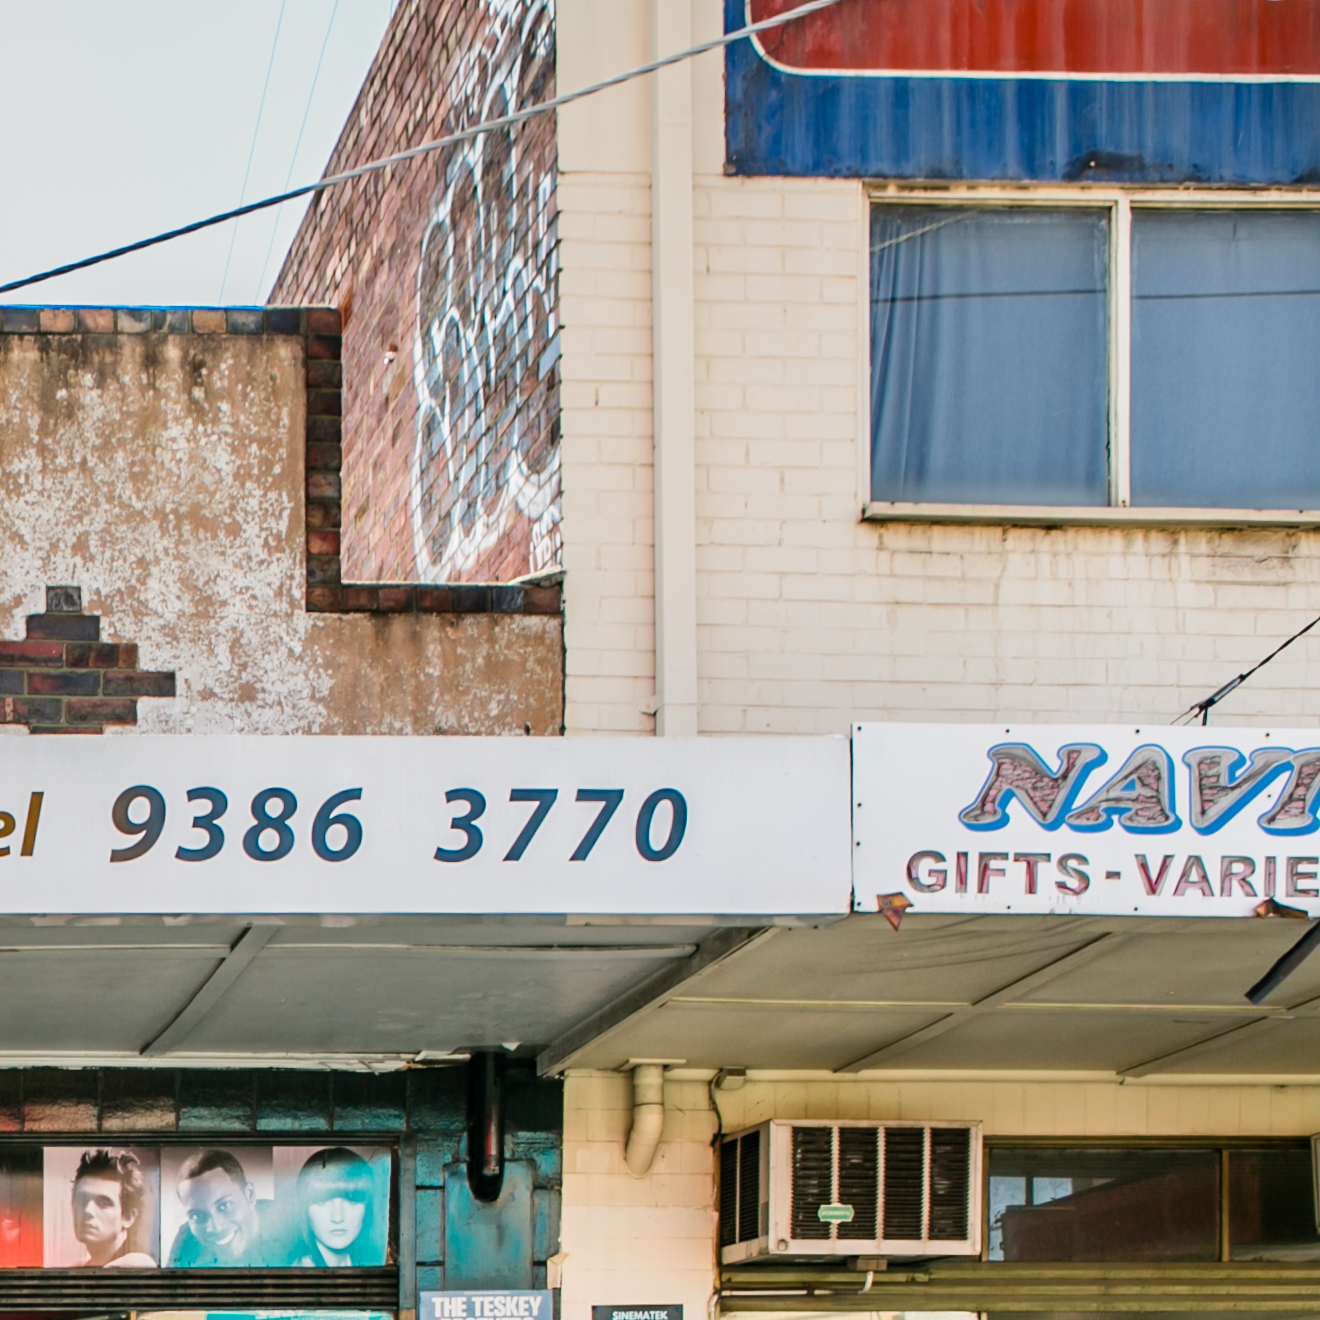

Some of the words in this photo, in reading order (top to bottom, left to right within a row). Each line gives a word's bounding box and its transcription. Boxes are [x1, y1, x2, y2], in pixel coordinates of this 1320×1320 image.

[109, 784, 365, 864] 9386
[433, 786, 689, 864] 3770
[431, 1296, 467, 1317] THE
[471, 1295, 542, 1317] TESKEY
[612, 1310, 668, 1320] SINEMATEK
